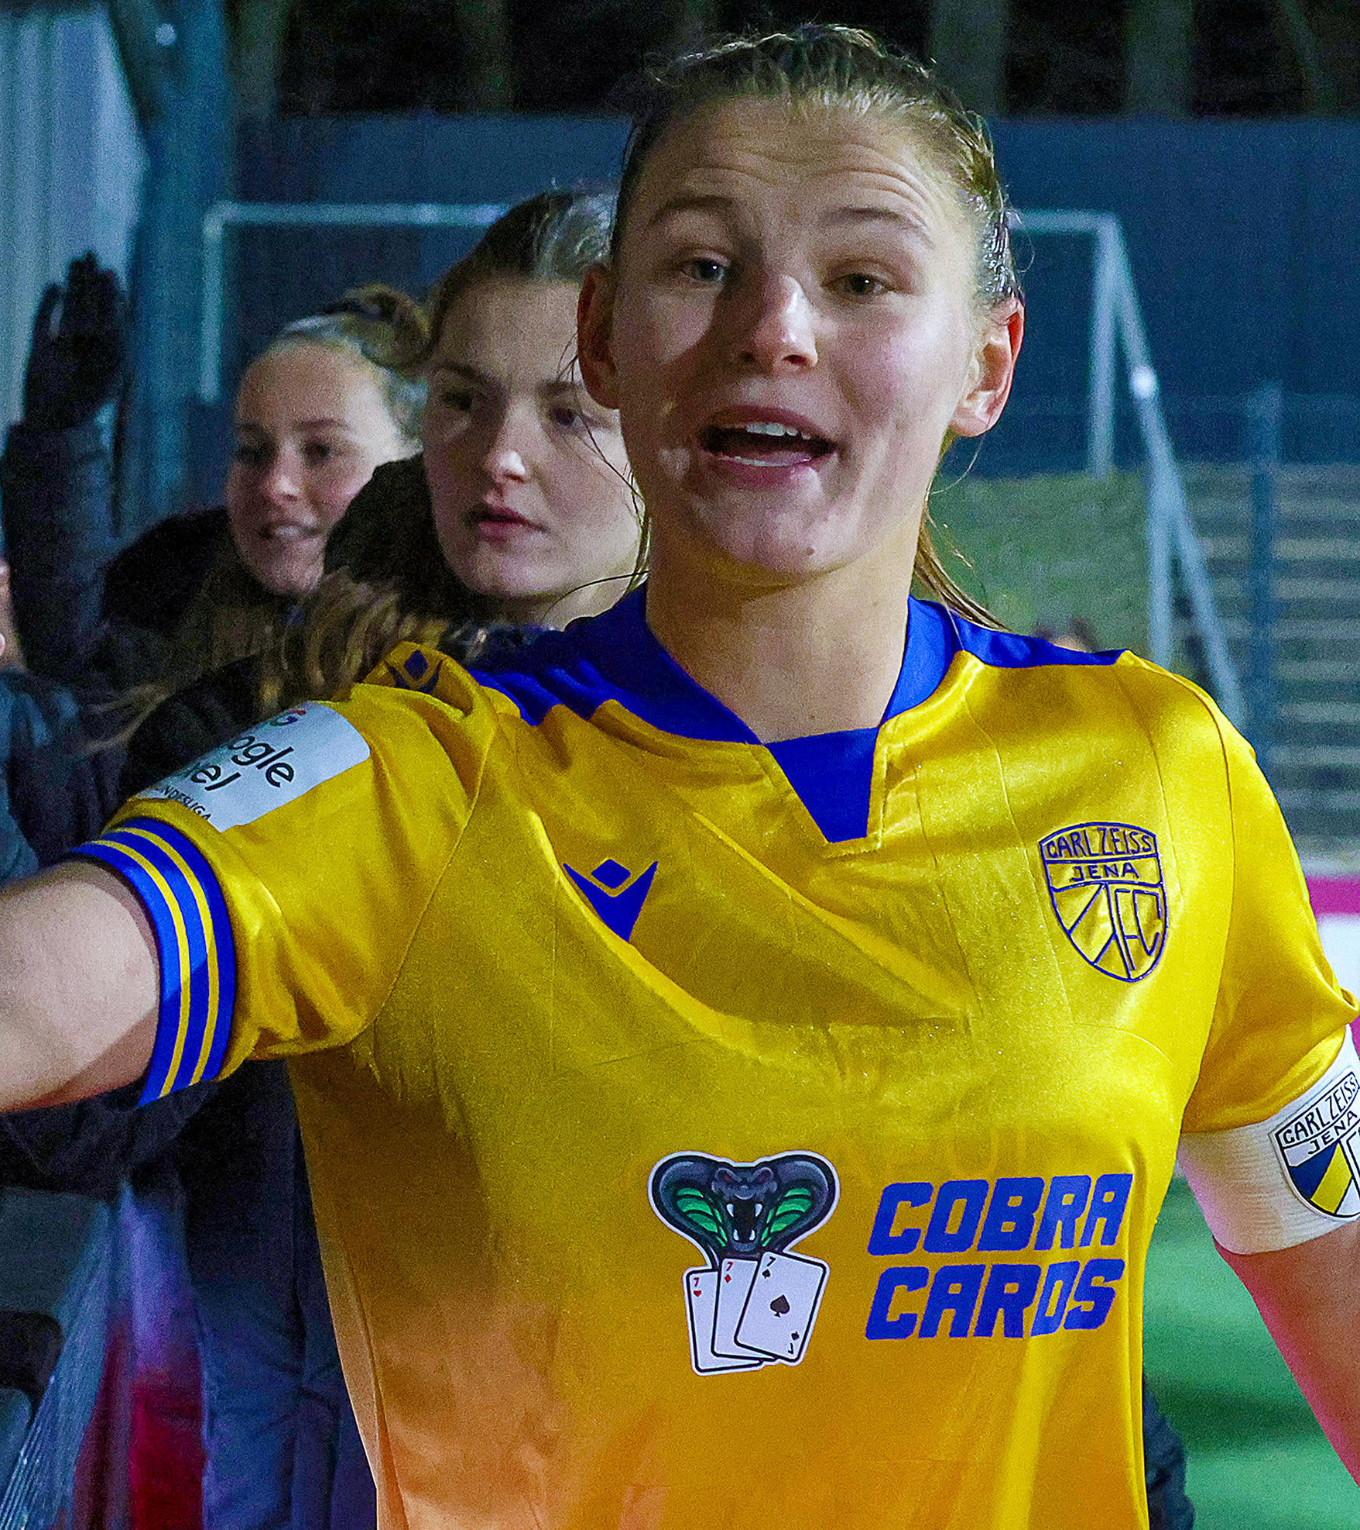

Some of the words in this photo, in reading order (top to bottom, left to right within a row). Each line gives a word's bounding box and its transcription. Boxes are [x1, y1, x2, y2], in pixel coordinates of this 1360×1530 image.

[226, 736, 295, 788] ogle
[159, 785, 212, 820] NDESLIGA
[1046, 829, 1100, 858] CARL
[1097, 827, 1153, 856] ZEISS
[1070, 862, 1140, 882] JENA
[1282, 1107, 1330, 1144] CARL
[1325, 1077, 1357, 1120] ZEISS
[1307, 1110, 1358, 1154] JENA
[866, 1173, 1133, 1256] COBRA
[726, 1261, 734, 1272] 7
[766, 1256, 777, 1267] 7
[693, 1277, 700, 1288] 7
[866, 1258, 1126, 1340] CARDS
